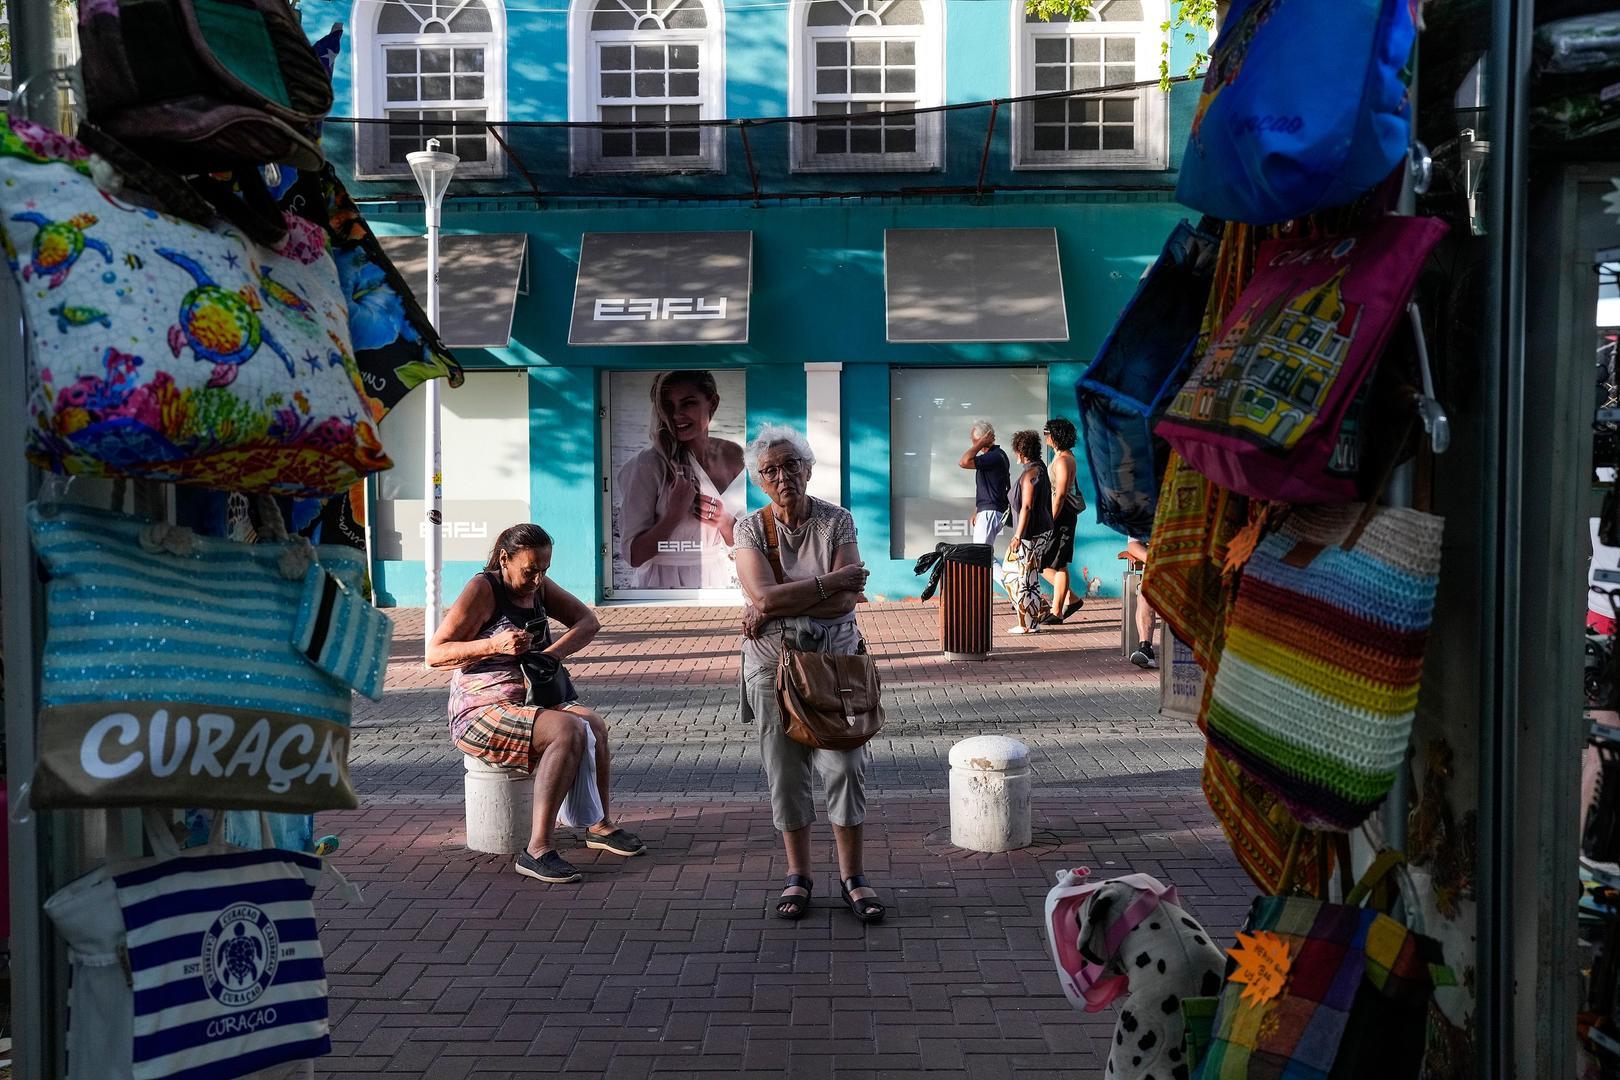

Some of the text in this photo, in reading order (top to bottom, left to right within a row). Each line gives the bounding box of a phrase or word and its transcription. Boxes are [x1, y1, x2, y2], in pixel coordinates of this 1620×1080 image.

[593, 297, 727, 320] EFFY
[657, 541, 703, 552] EFFY
[206, 1008, 277, 1037] CURAÇAO
